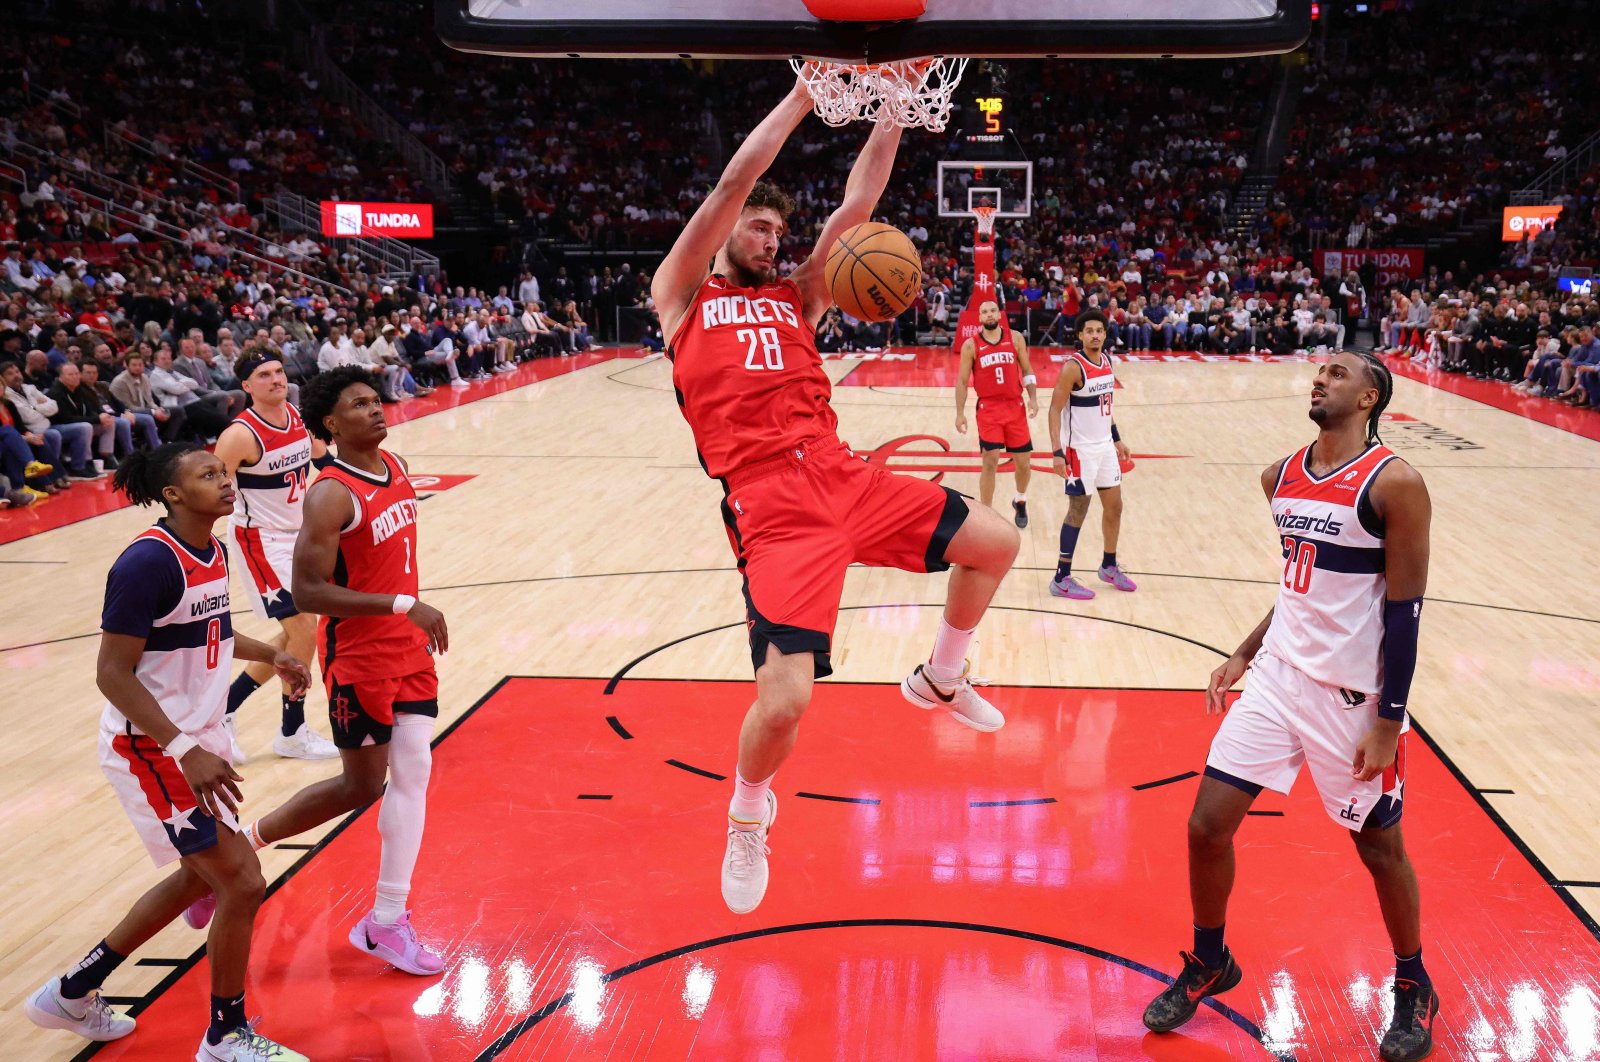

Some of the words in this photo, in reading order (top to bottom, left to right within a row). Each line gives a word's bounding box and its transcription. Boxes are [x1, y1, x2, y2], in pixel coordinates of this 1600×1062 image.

[986, 111, 999, 132] 5
[365, 213, 420, 228] TUNDRA
[702, 295, 798, 330] ROCKETS
[736, 327, 784, 370] 28
[980, 352, 1014, 369] ROCKETS
[995, 366, 1004, 384] 9
[1099, 393, 1112, 416] 13
[268, 444, 310, 471] wizards
[284, 467, 307, 505] 24
[370, 498, 417, 546] ROCKET
[403, 537, 411, 574] 1
[1284, 537, 1316, 595] 20
[207, 618, 220, 670] 8
